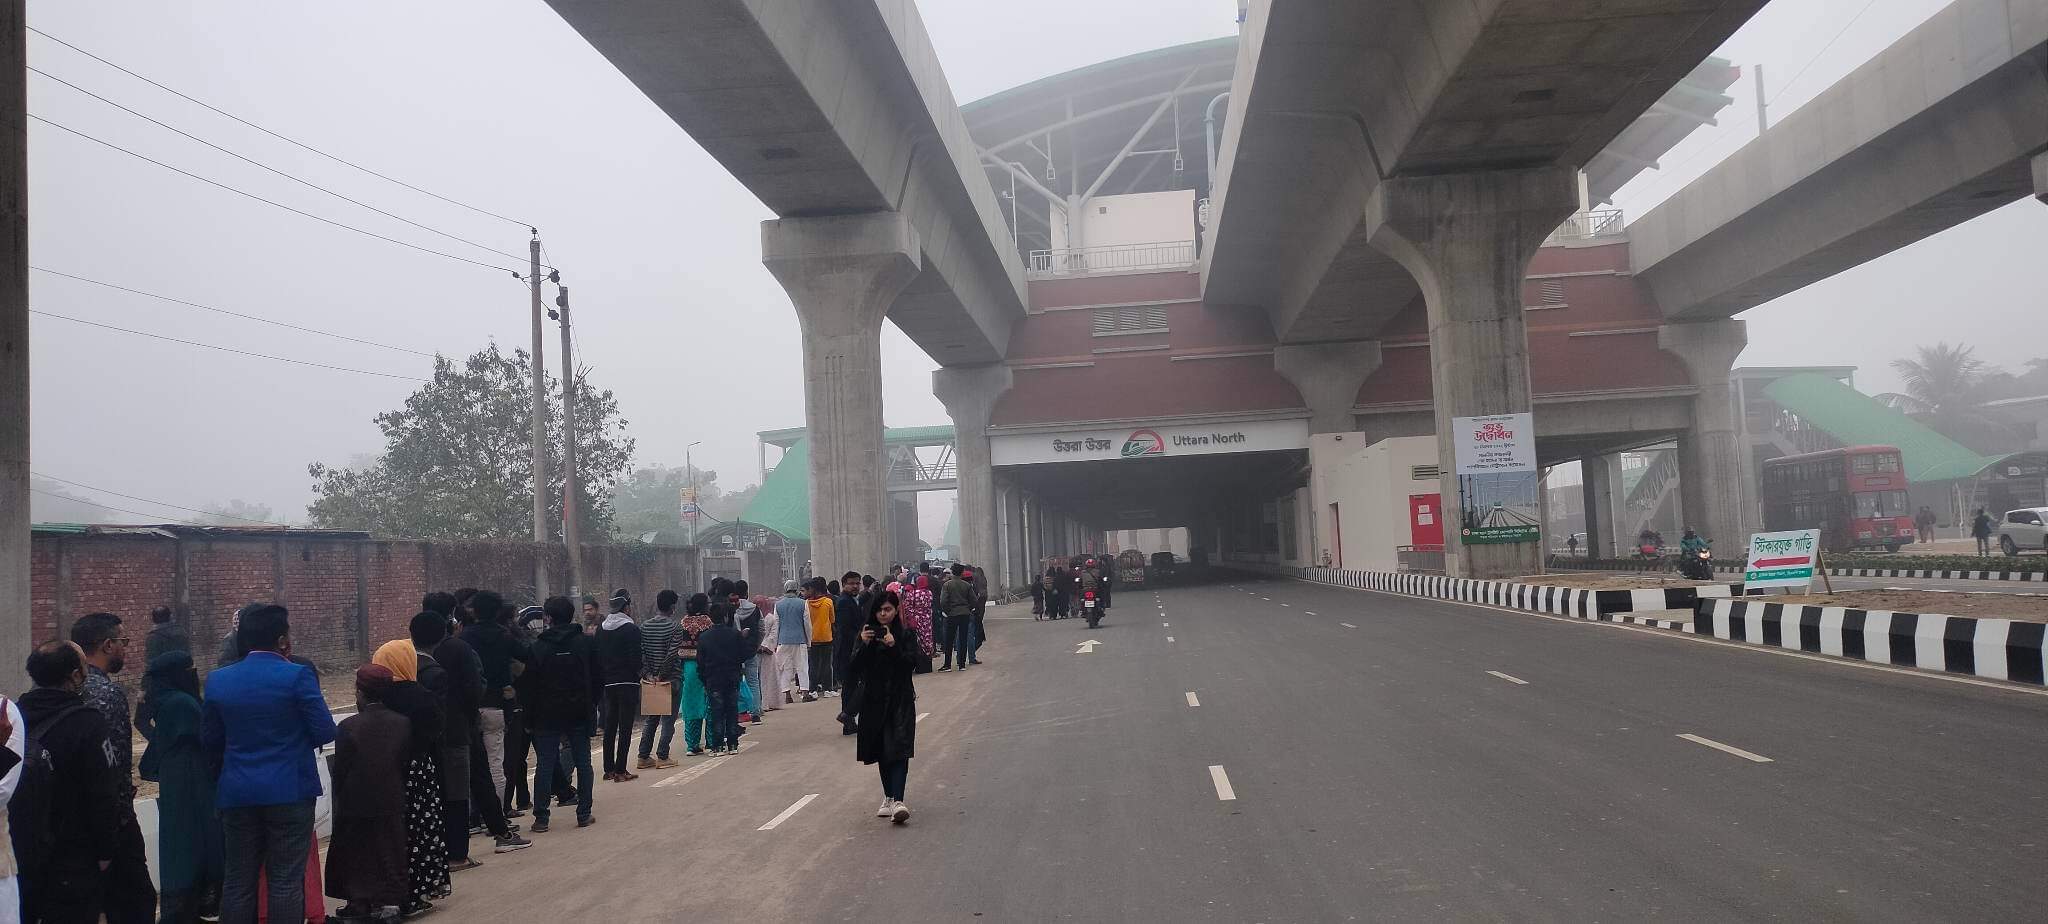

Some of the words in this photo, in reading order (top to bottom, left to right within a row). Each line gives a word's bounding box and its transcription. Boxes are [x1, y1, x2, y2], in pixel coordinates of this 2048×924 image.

[1482, 422, 1504, 432] শুভ
[1173, 435, 1208, 446] Uttara
[1211, 432, 1246, 445] North
[1474, 430, 1513, 442] উদ্বোধন
[1052, 439, 1082, 452] উত্তরা
[1084, 437, 1112, 450] উত্তর
[1753, 536, 1793, 555] স্টিকারযুক্ত
[1795, 533, 1813, 553] গাড়ি
